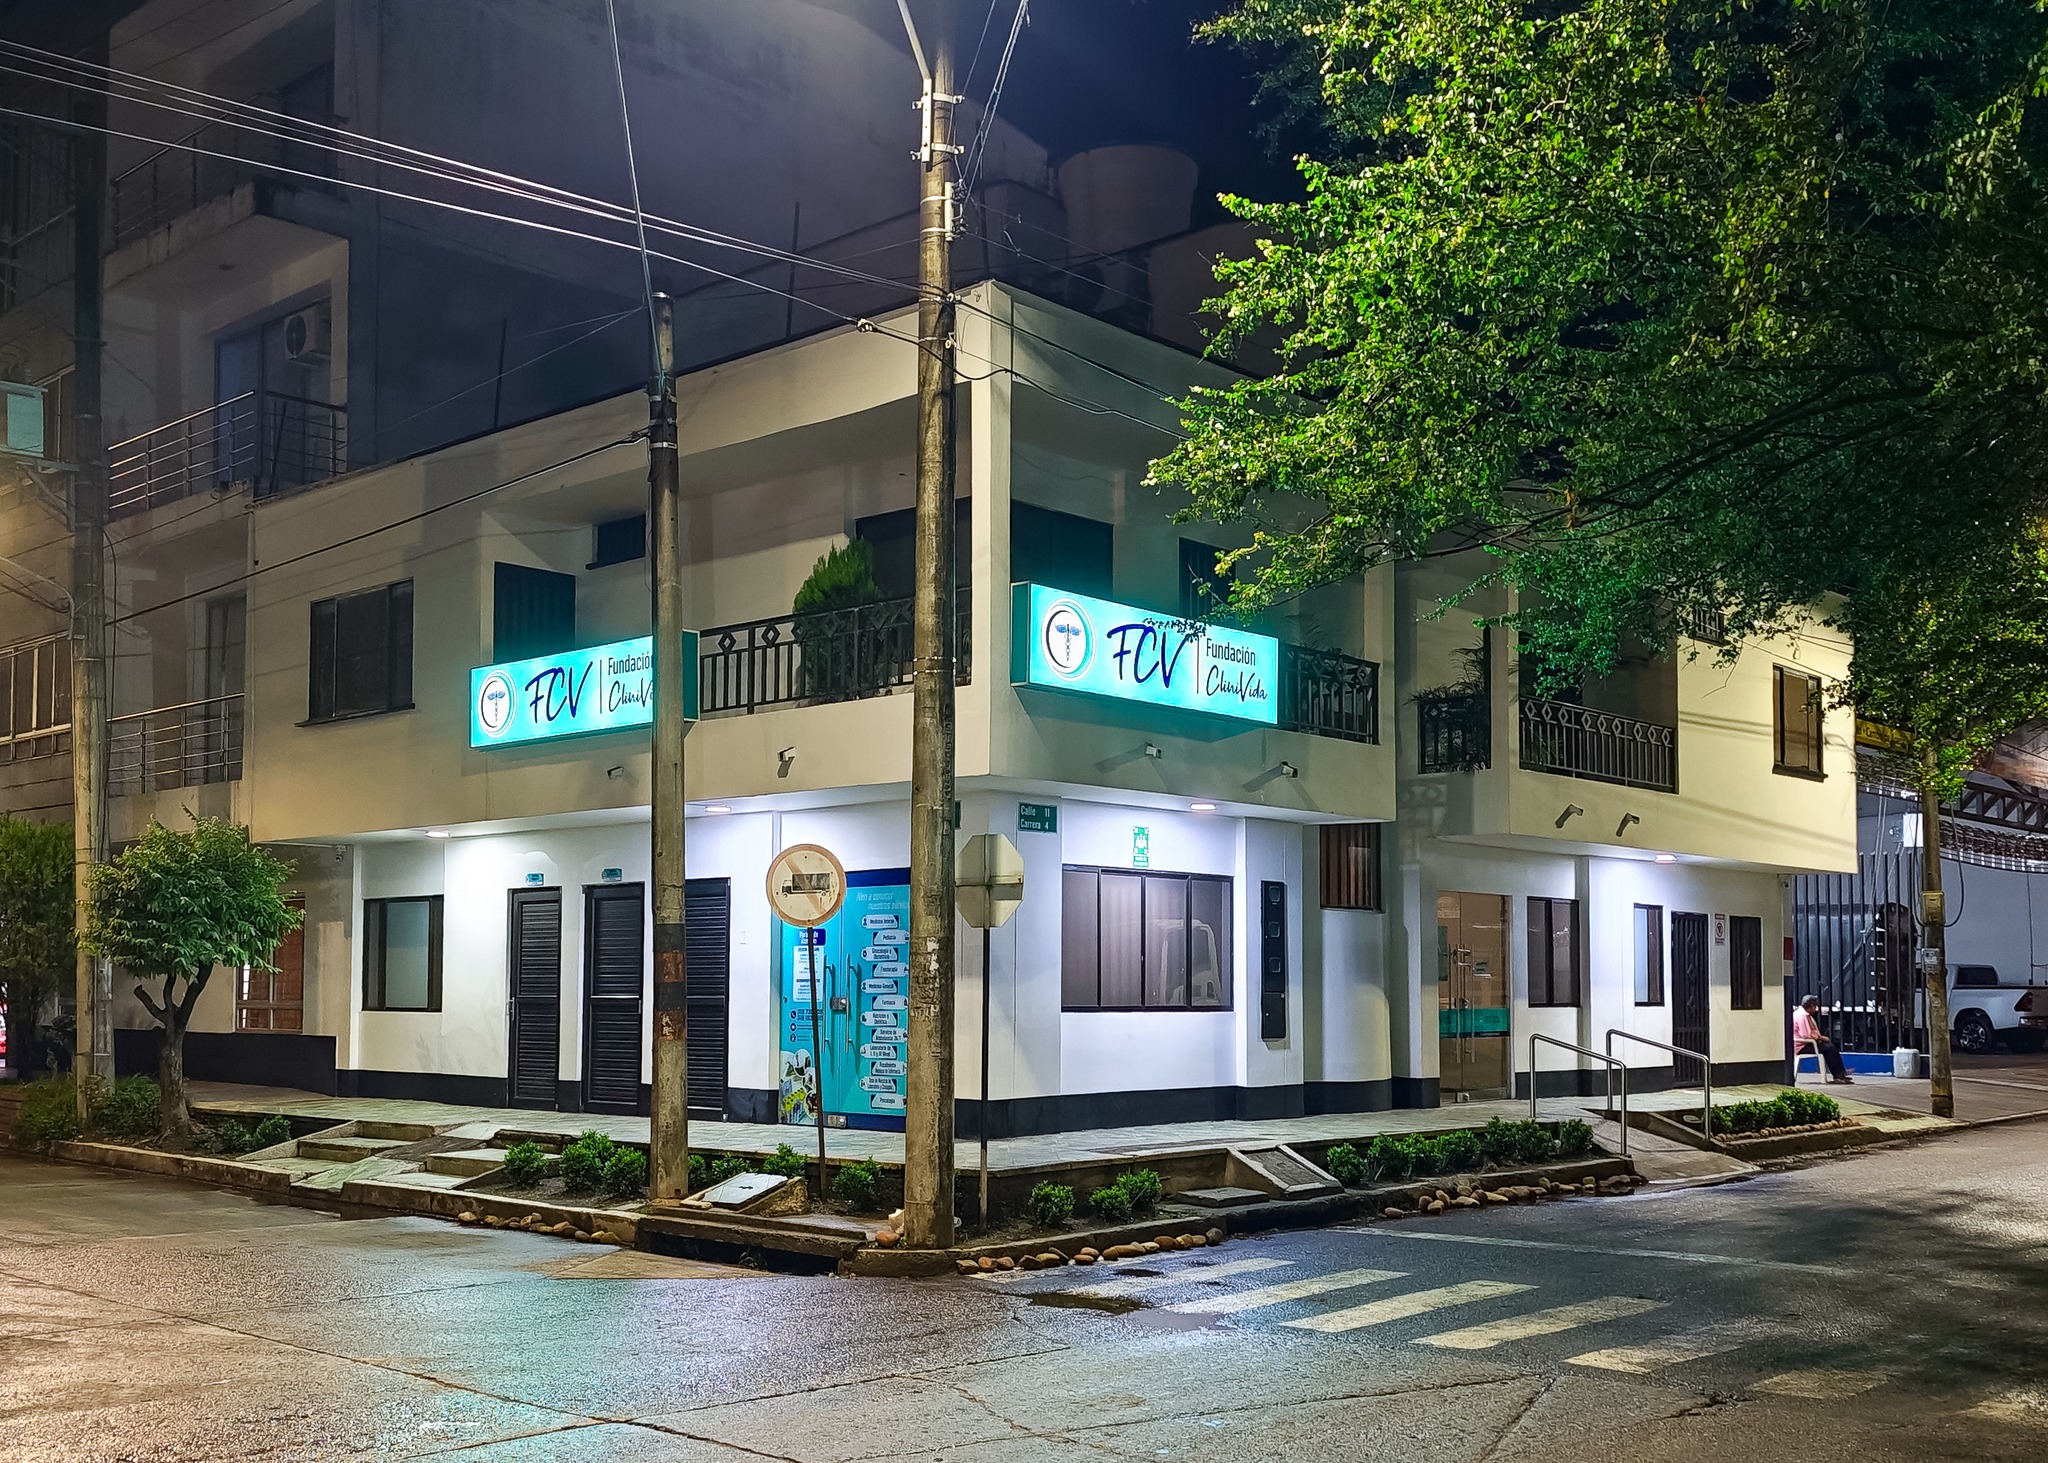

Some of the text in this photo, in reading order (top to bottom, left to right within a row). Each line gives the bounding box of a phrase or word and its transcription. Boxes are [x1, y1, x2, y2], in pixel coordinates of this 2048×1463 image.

[1107, 624, 1189, 688] FCV
[1206, 638, 1256, 666] Fundación
[525, 661, 593, 724] FCV
[1206, 665, 1268, 702] CliniVida
[1021, 805, 1050, 818] Calle 11
[1021, 819, 1049, 830] Carrera 4
